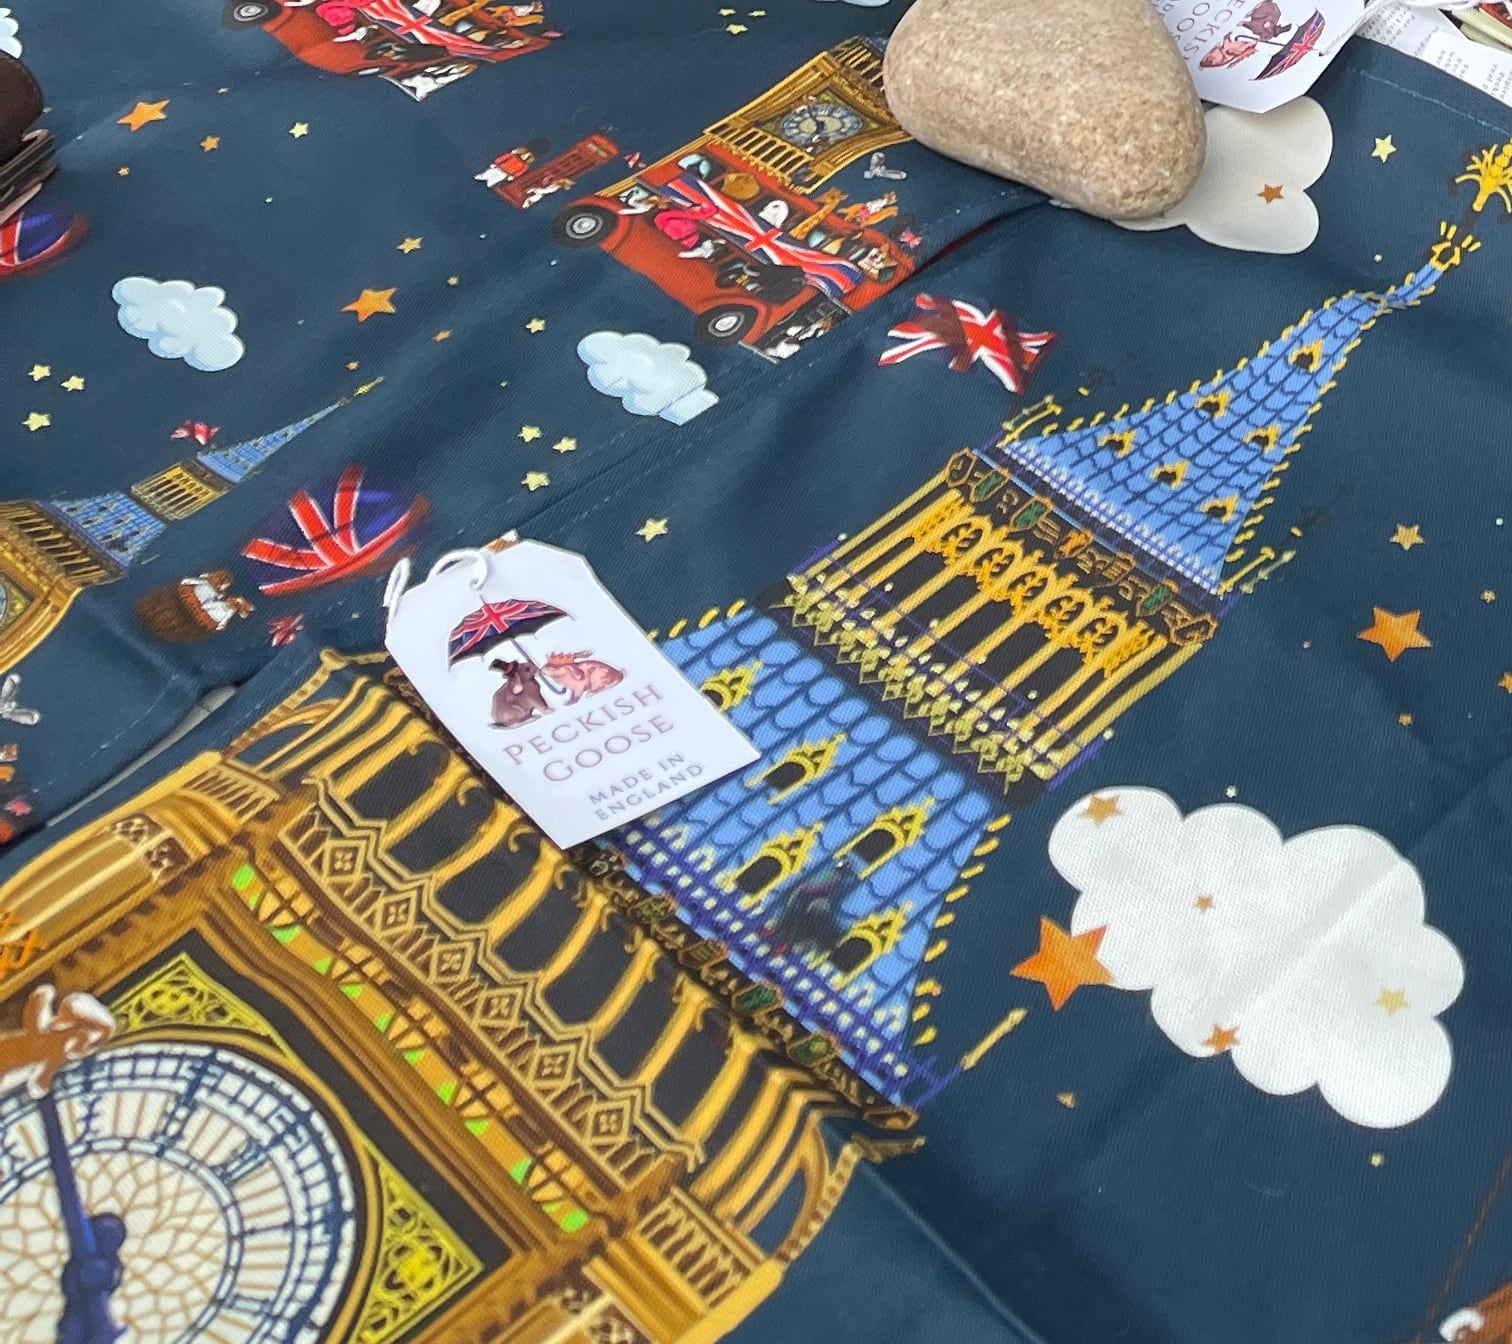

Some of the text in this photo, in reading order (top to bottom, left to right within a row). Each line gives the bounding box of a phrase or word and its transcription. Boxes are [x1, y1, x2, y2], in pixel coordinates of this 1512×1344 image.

[503, 684, 664, 765] PECKISH
[542, 715, 674, 781] GOOSE
[588, 752, 686, 805] MADE IN
[594, 764, 703, 821] ENGLAND
